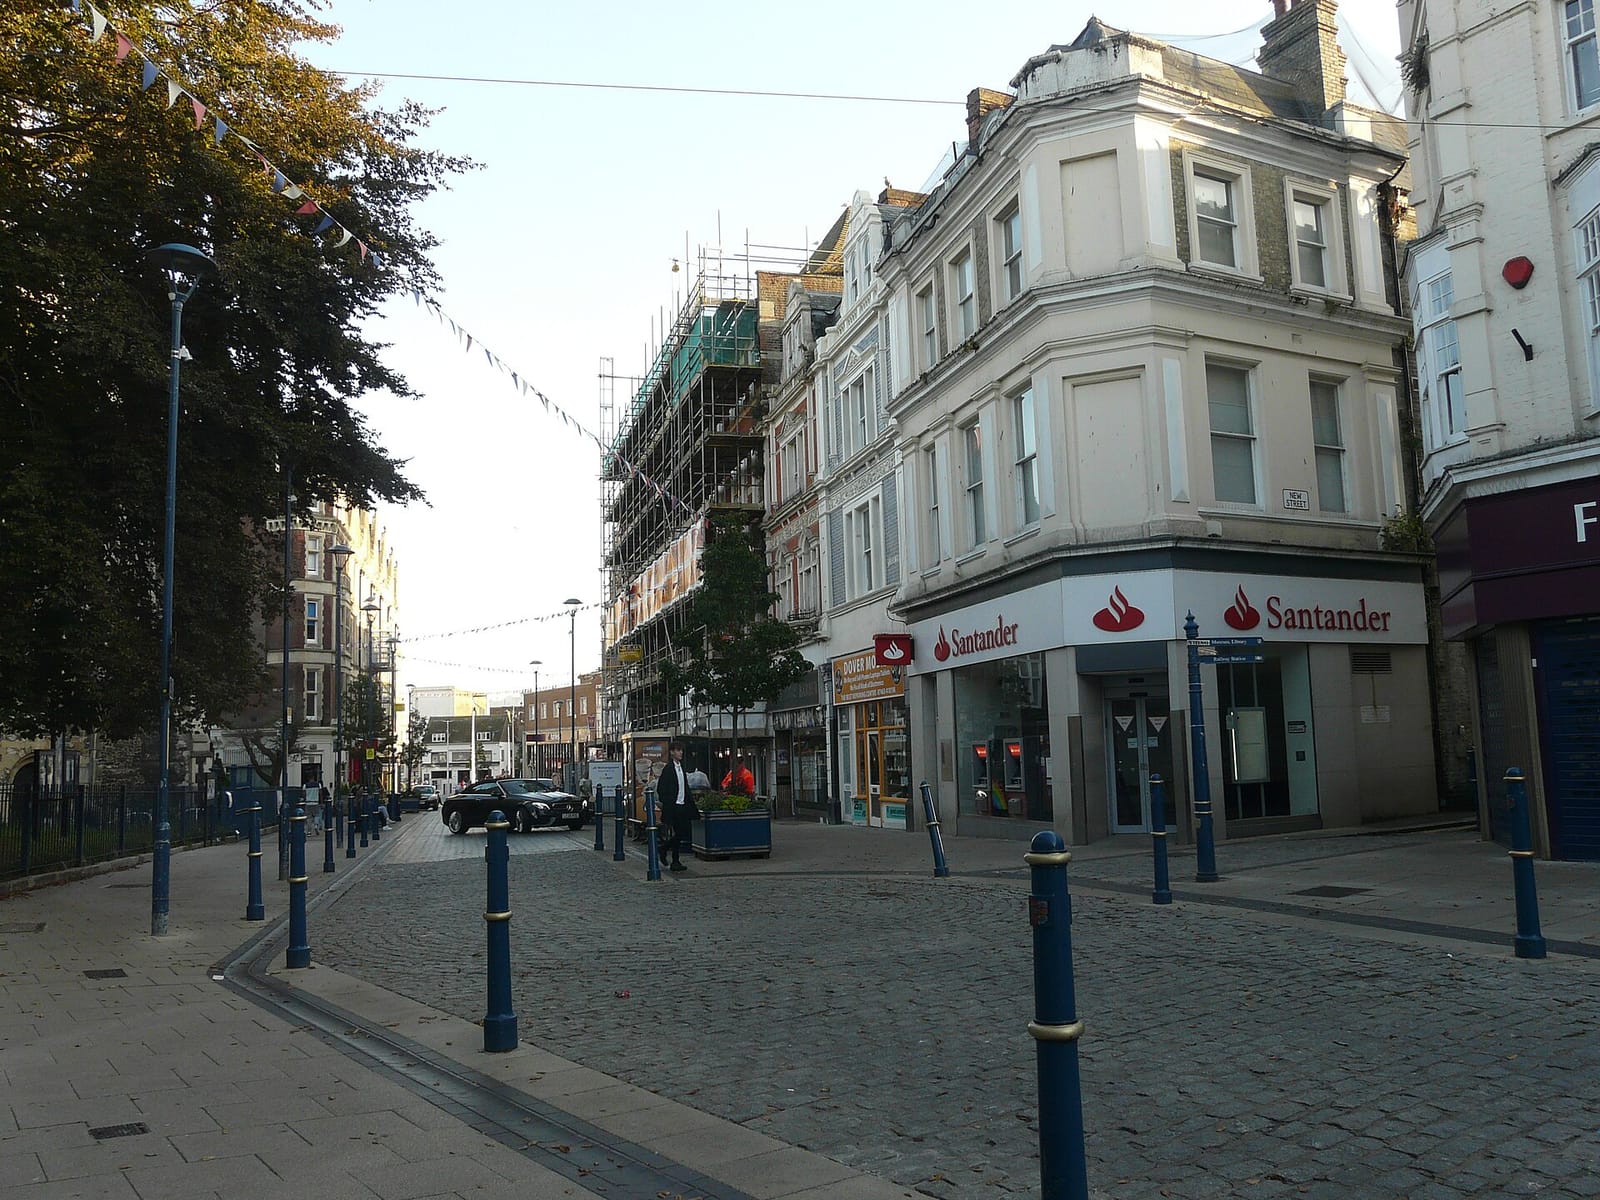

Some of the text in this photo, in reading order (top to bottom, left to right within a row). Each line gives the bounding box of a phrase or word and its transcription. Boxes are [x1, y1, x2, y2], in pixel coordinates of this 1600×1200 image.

[1289, 491, 1302, 499] NEW
[1286, 500, 1306, 508] STREET
[1266, 596, 1391, 632] Santander
[951, 613, 1019, 657] Santander
[843, 658, 865, 675] DOVER
